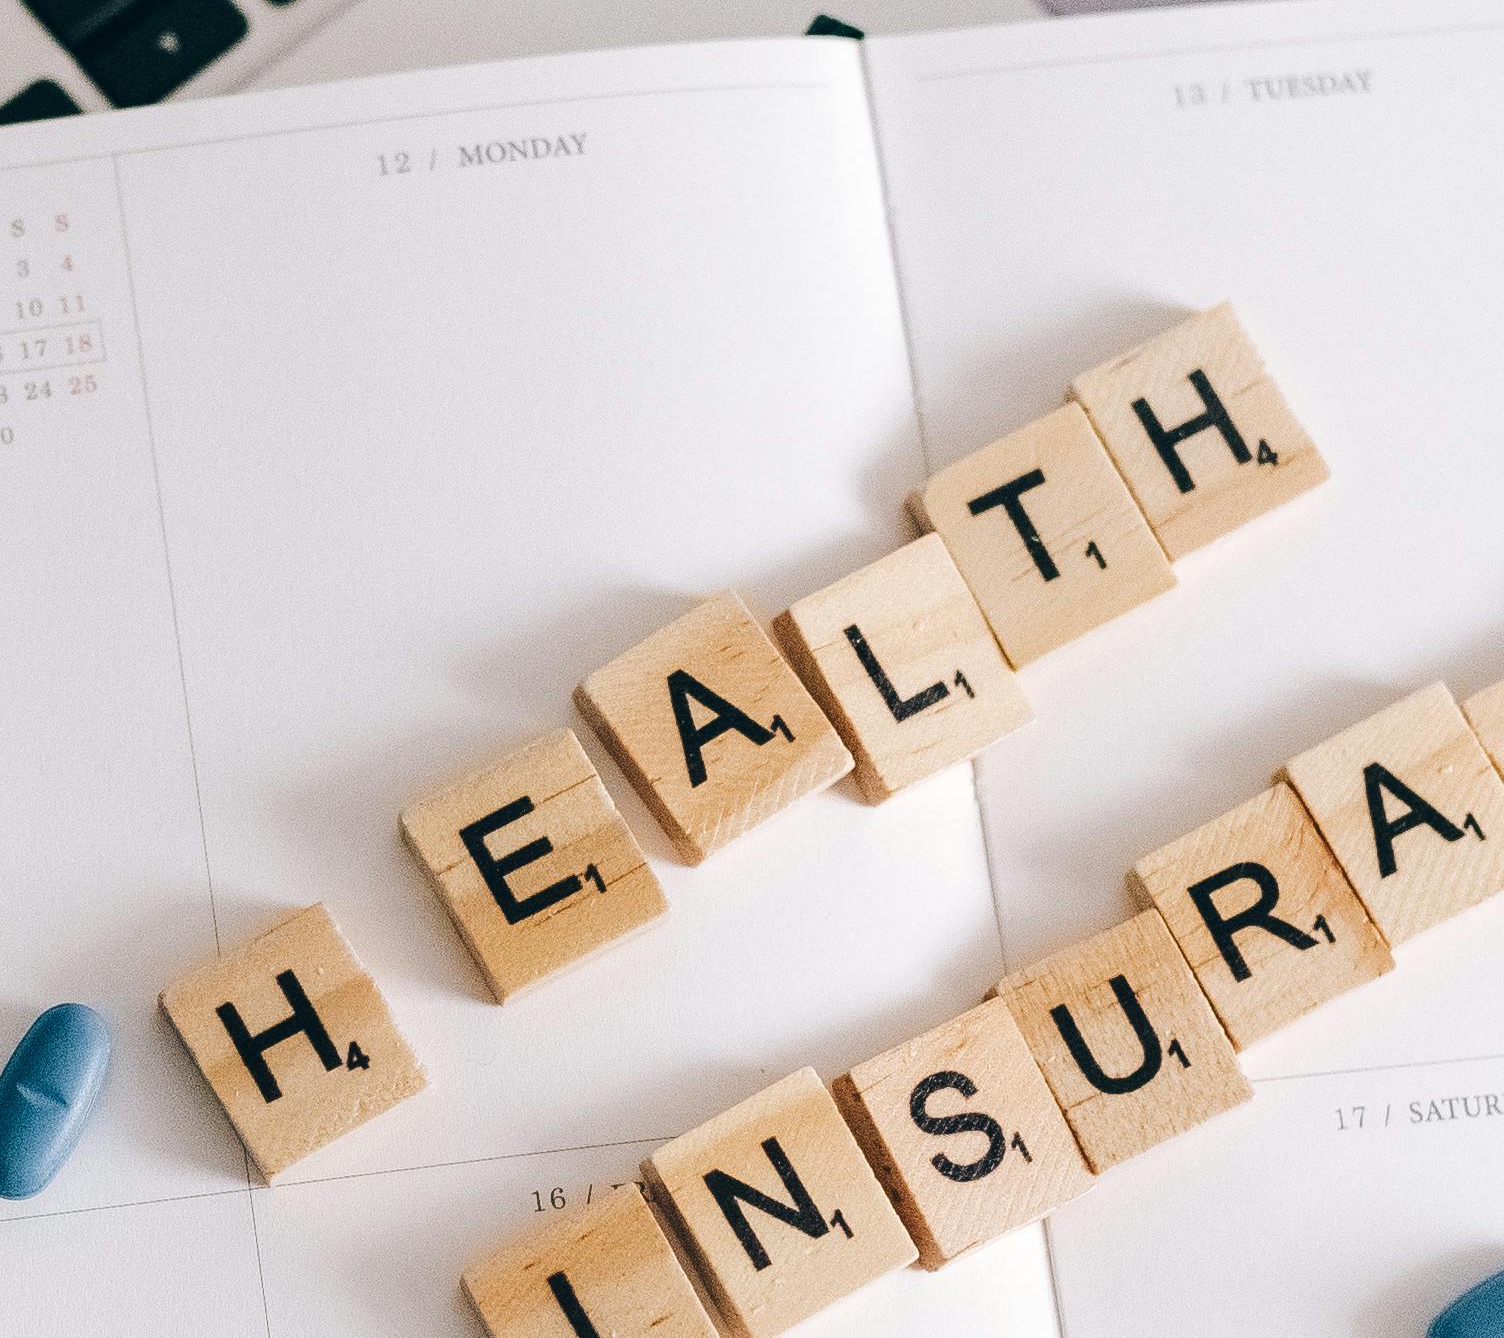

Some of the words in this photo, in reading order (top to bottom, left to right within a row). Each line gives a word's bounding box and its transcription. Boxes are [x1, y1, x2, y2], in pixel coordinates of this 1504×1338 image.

[1245, 69, 1371, 102] TUESDAY
[377, 151, 412, 177] 12
[457, 133, 586, 168] MONDAY
[10, 218, 26, 239] S
[54, 213, 70, 233] S
[16, 258, 31, 279] 3
[15, 298, 44, 320] 10
[59, 293, 86, 315] 11
[20, 337, 48, 361] 17
[65, 334, 93, 355] 18
[24, 380, 53, 402] 24
[68, 374, 99, 396] 25
[1257, 439, 1278, 466] 4
[1085, 541, 1107, 570] 1
[953, 670, 975, 699] 1
[771, 714, 796, 743] 1
[1463, 813, 1486, 841] 1
[583, 863, 607, 894] 1
[1313, 914, 1336, 944] 1
[346, 1041, 370, 1071] 4
[1167, 1038, 1191, 1069] 1
[1335, 1104, 1367, 1132] 17
[1011, 1132, 1033, 1163] 1
[533, 1187, 568, 1213] 16
[829, 1209, 854, 1239] 1
